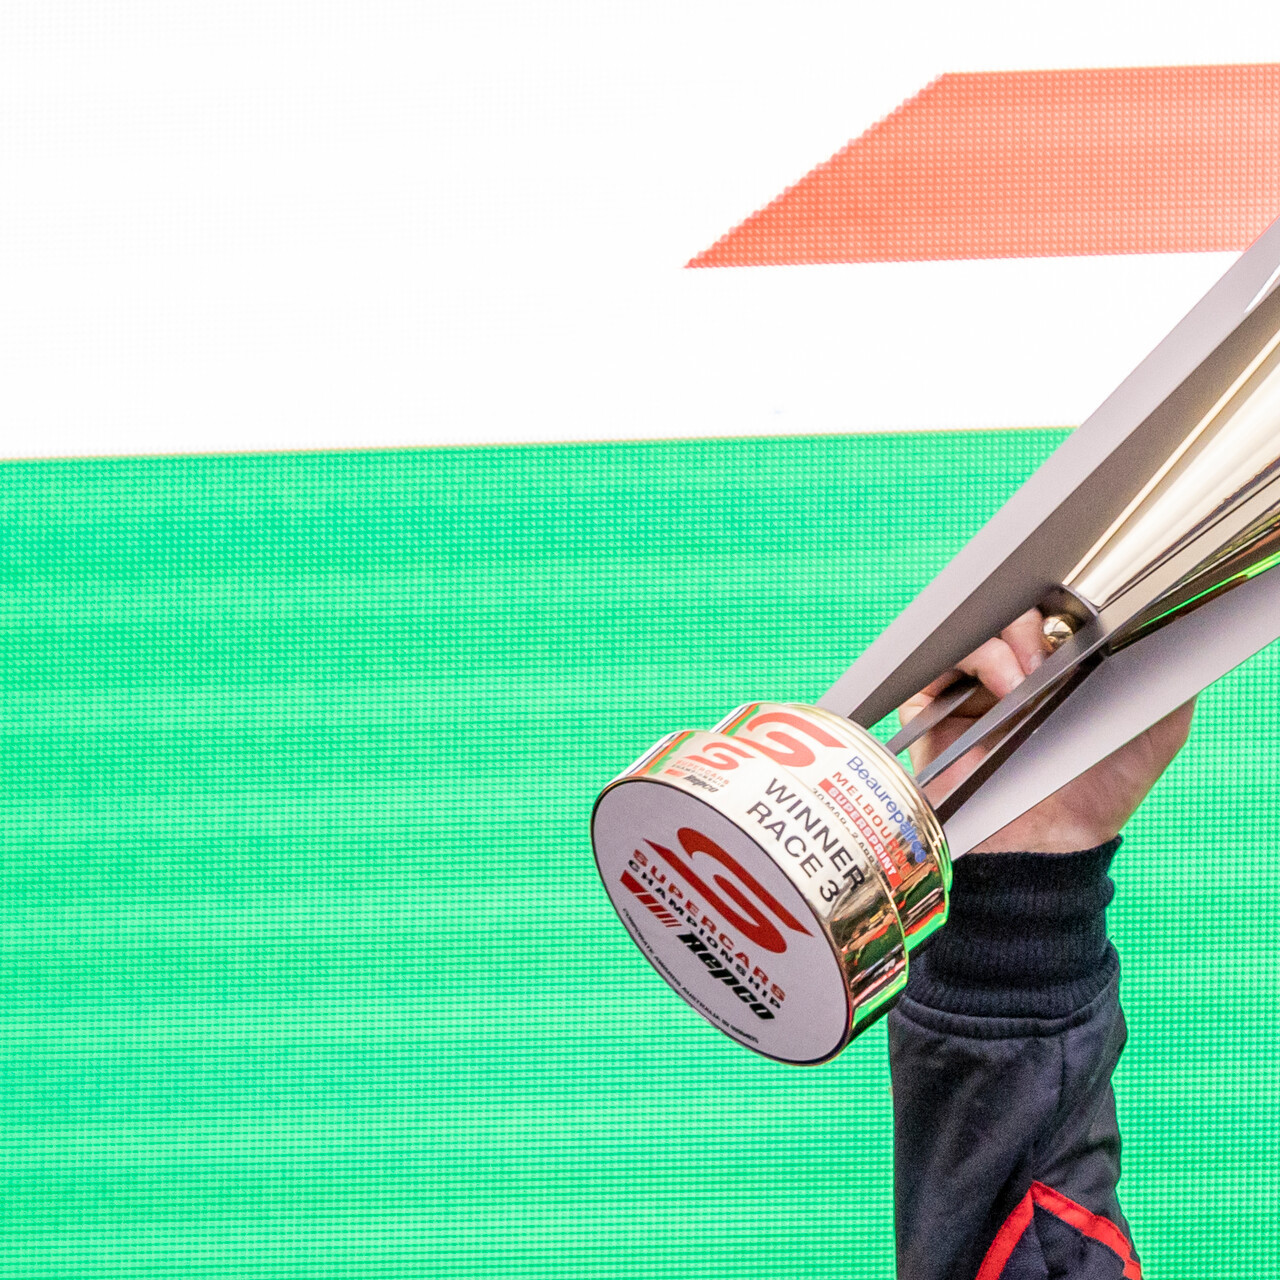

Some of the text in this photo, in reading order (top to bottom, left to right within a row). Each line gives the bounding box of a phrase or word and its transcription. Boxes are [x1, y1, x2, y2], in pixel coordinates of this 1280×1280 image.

[746, 800, 840, 903] RACE 3
[765, 777, 866, 891] WINNER
[828, 786, 899, 876] SUPERSPRINT
[832, 771, 914, 876] MELBOURNE
[628, 859, 781, 1010] CHAMPIONSHIP
[633, 849, 786, 1002] SUPERCARS
[676, 930, 776, 1020] Repco
